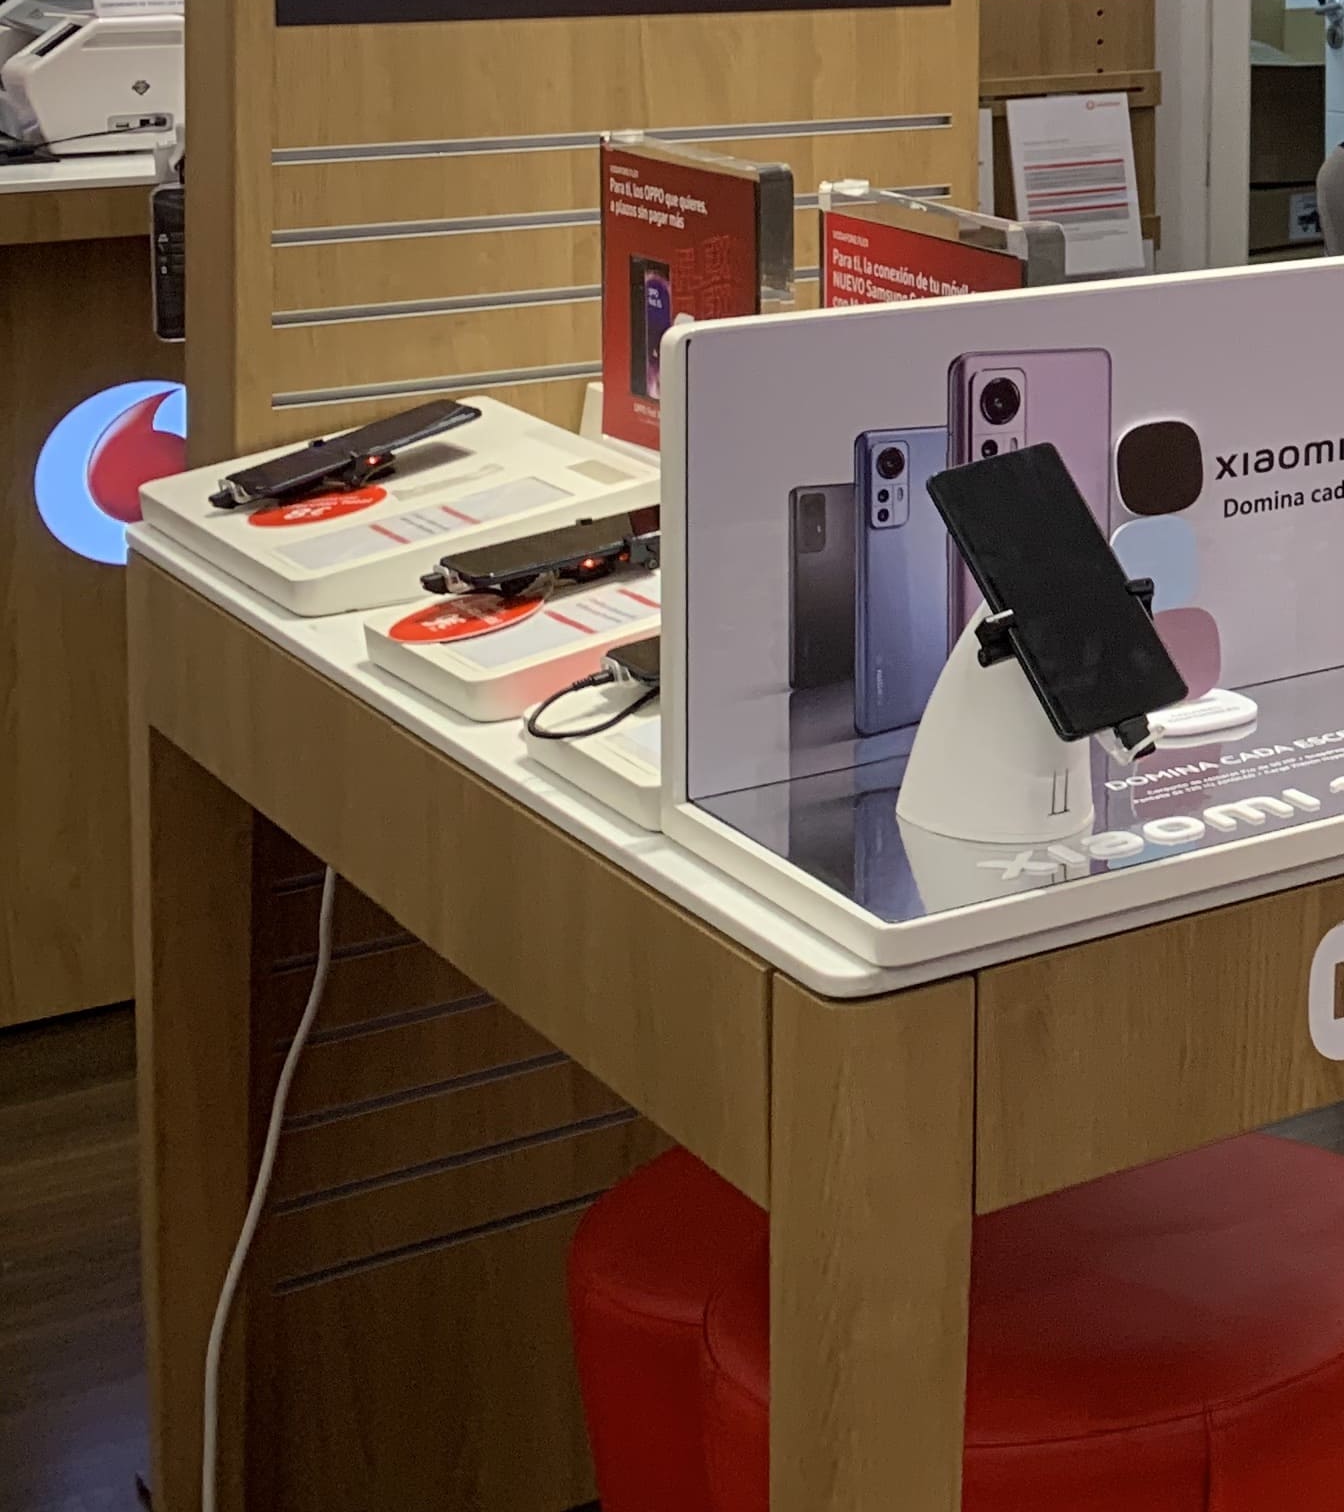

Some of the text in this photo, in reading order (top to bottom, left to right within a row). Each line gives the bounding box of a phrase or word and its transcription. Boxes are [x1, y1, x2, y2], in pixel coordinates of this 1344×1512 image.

[644, 185, 664, 204] OPPO
[832, 249, 851, 268] Para
[863, 256, 872, 274] la
[873, 264, 915, 286] conexión
[915, 272, 929, 290] de
[929, 275, 940, 294] tu
[832, 271, 865, 295] NUEVO
[1223, 489, 1305, 518] Domina
[1104, 760, 1220, 791] DOMINA
[1219, 743, 1294, 765] CADA
